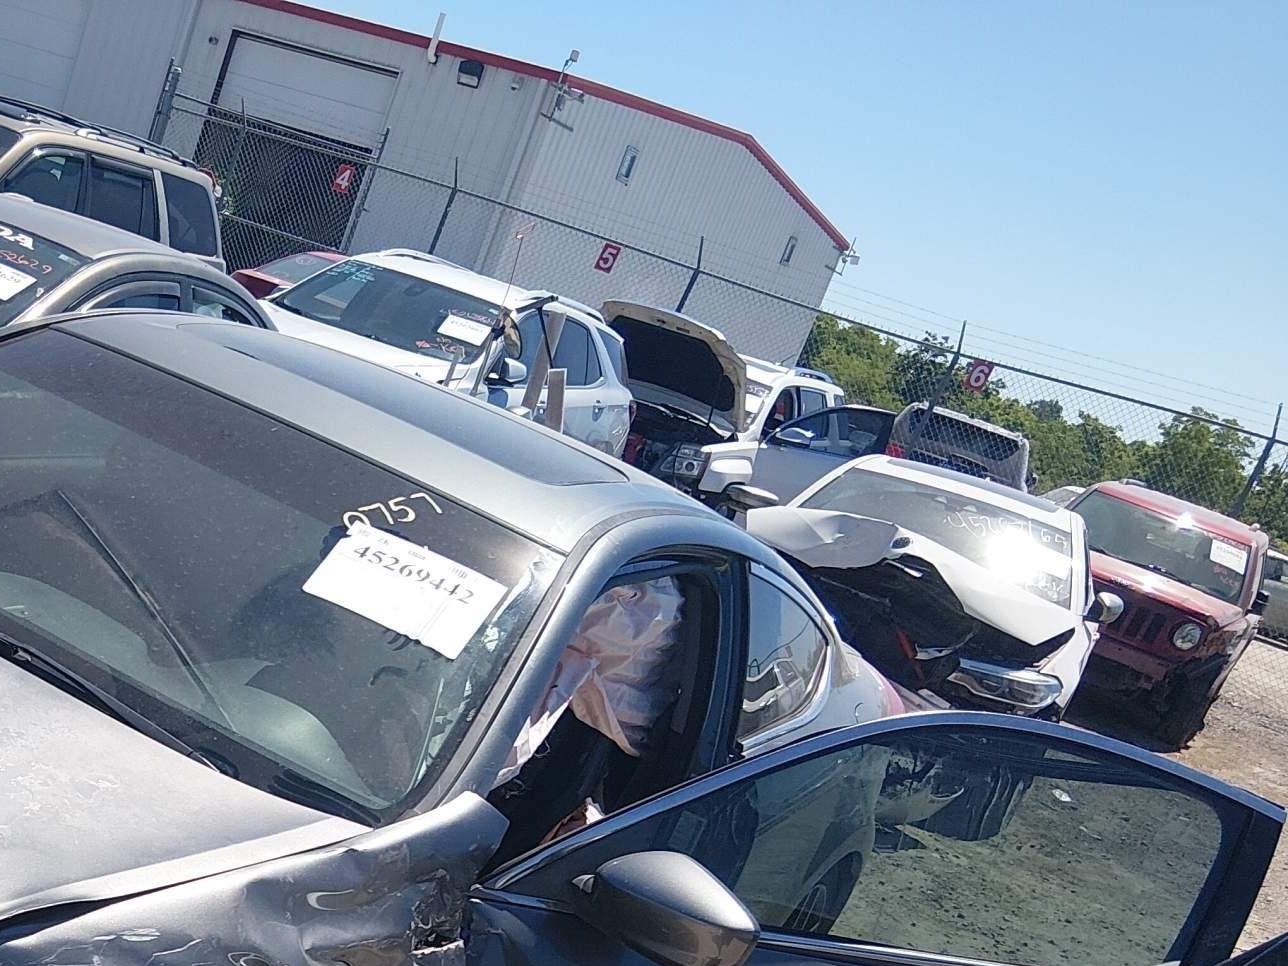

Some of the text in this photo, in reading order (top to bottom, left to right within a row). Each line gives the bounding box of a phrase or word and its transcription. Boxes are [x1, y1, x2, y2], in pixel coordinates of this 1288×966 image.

[336, 169, 351, 190] 4
[599, 247, 618, 269] 5
[969, 365, 990, 387] 6
[353, 546, 475, 605] 45269442
